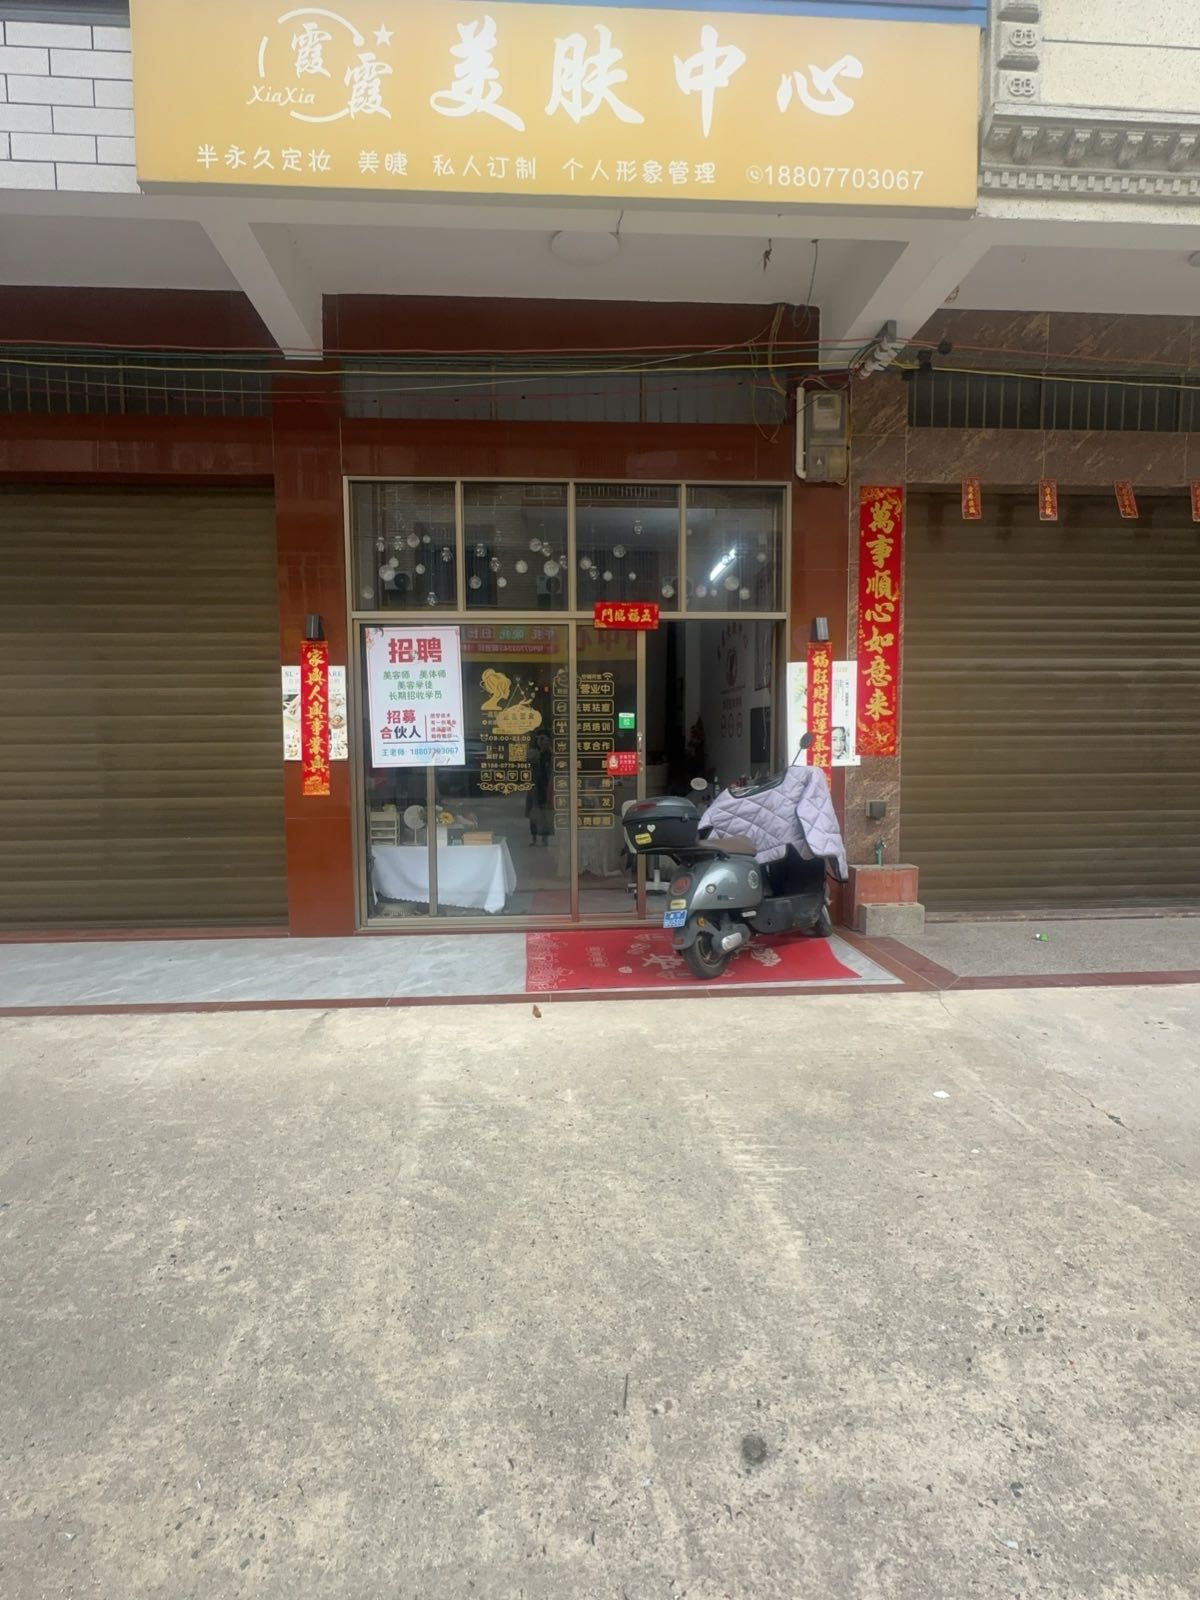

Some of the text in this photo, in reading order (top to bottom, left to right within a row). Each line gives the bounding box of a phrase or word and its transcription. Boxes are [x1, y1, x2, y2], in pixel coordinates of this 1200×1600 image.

[291, 22, 393, 120] 霞霞
[430, 14, 864, 138] 美肤中心
[246, 85, 316, 106] XiaXia
[196, 144, 925, 192] 半永久定妆 美睫 私人订制 个人形象管理 18807703067
[389, 638, 442, 663] 招聘
[383, 670, 410, 680] 美容师
[388, 691, 443, 702] 长期招收学员
[580, 683, 612, 695] 营业中
[386, 709, 416, 724] 招募
[380, 725, 421, 740] 合伙人
